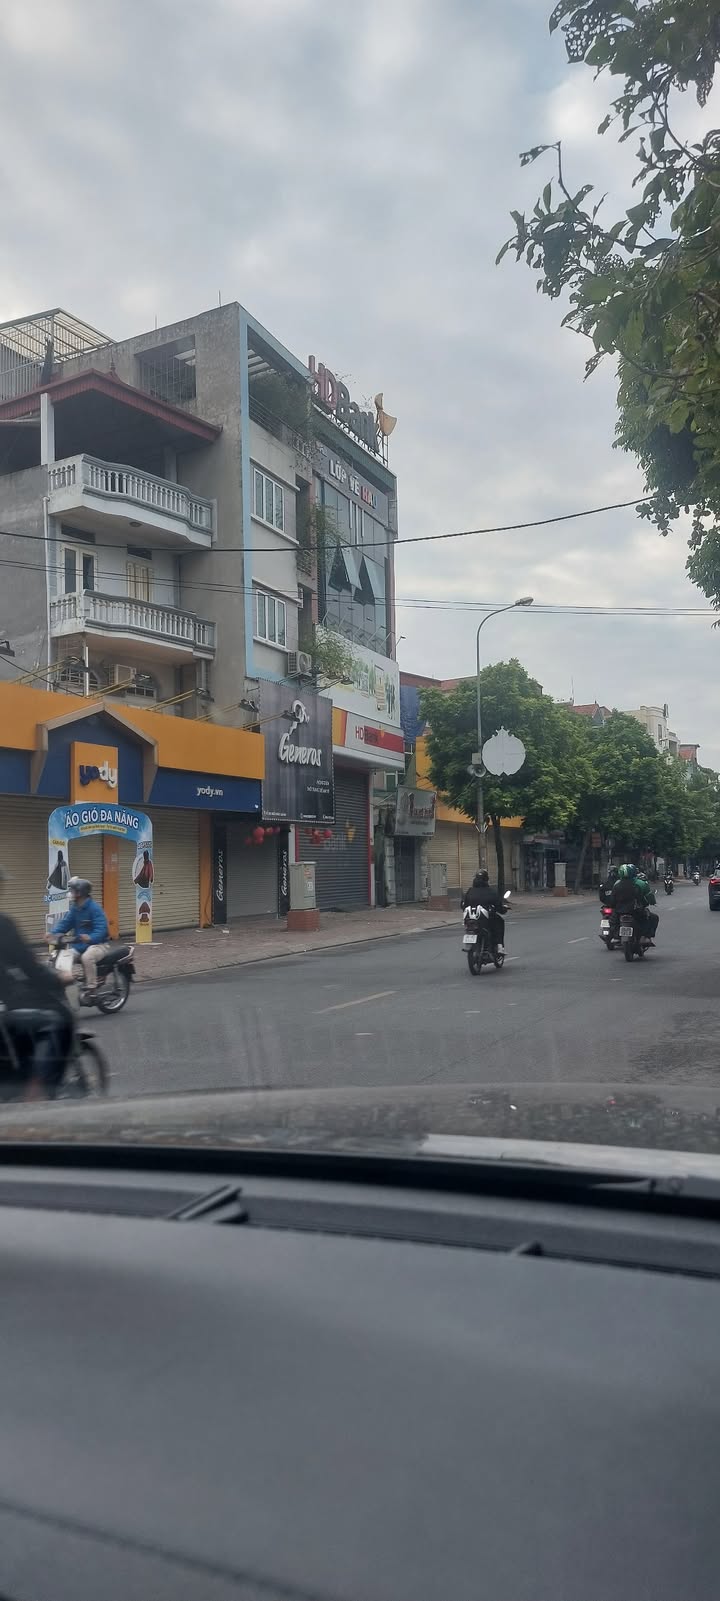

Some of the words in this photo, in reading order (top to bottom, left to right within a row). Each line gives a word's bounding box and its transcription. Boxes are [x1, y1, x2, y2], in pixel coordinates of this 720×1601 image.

[279, 732, 322, 767] Generos
[79, 760, 118, 788] yody
[196, 786, 223, 797] yody.vn
[81, 807, 99, 822] GIÓ
[100, 809, 113, 822] ĐA
[114, 808, 139, 829] NĂNG
[216, 849, 224, 901] Generos
